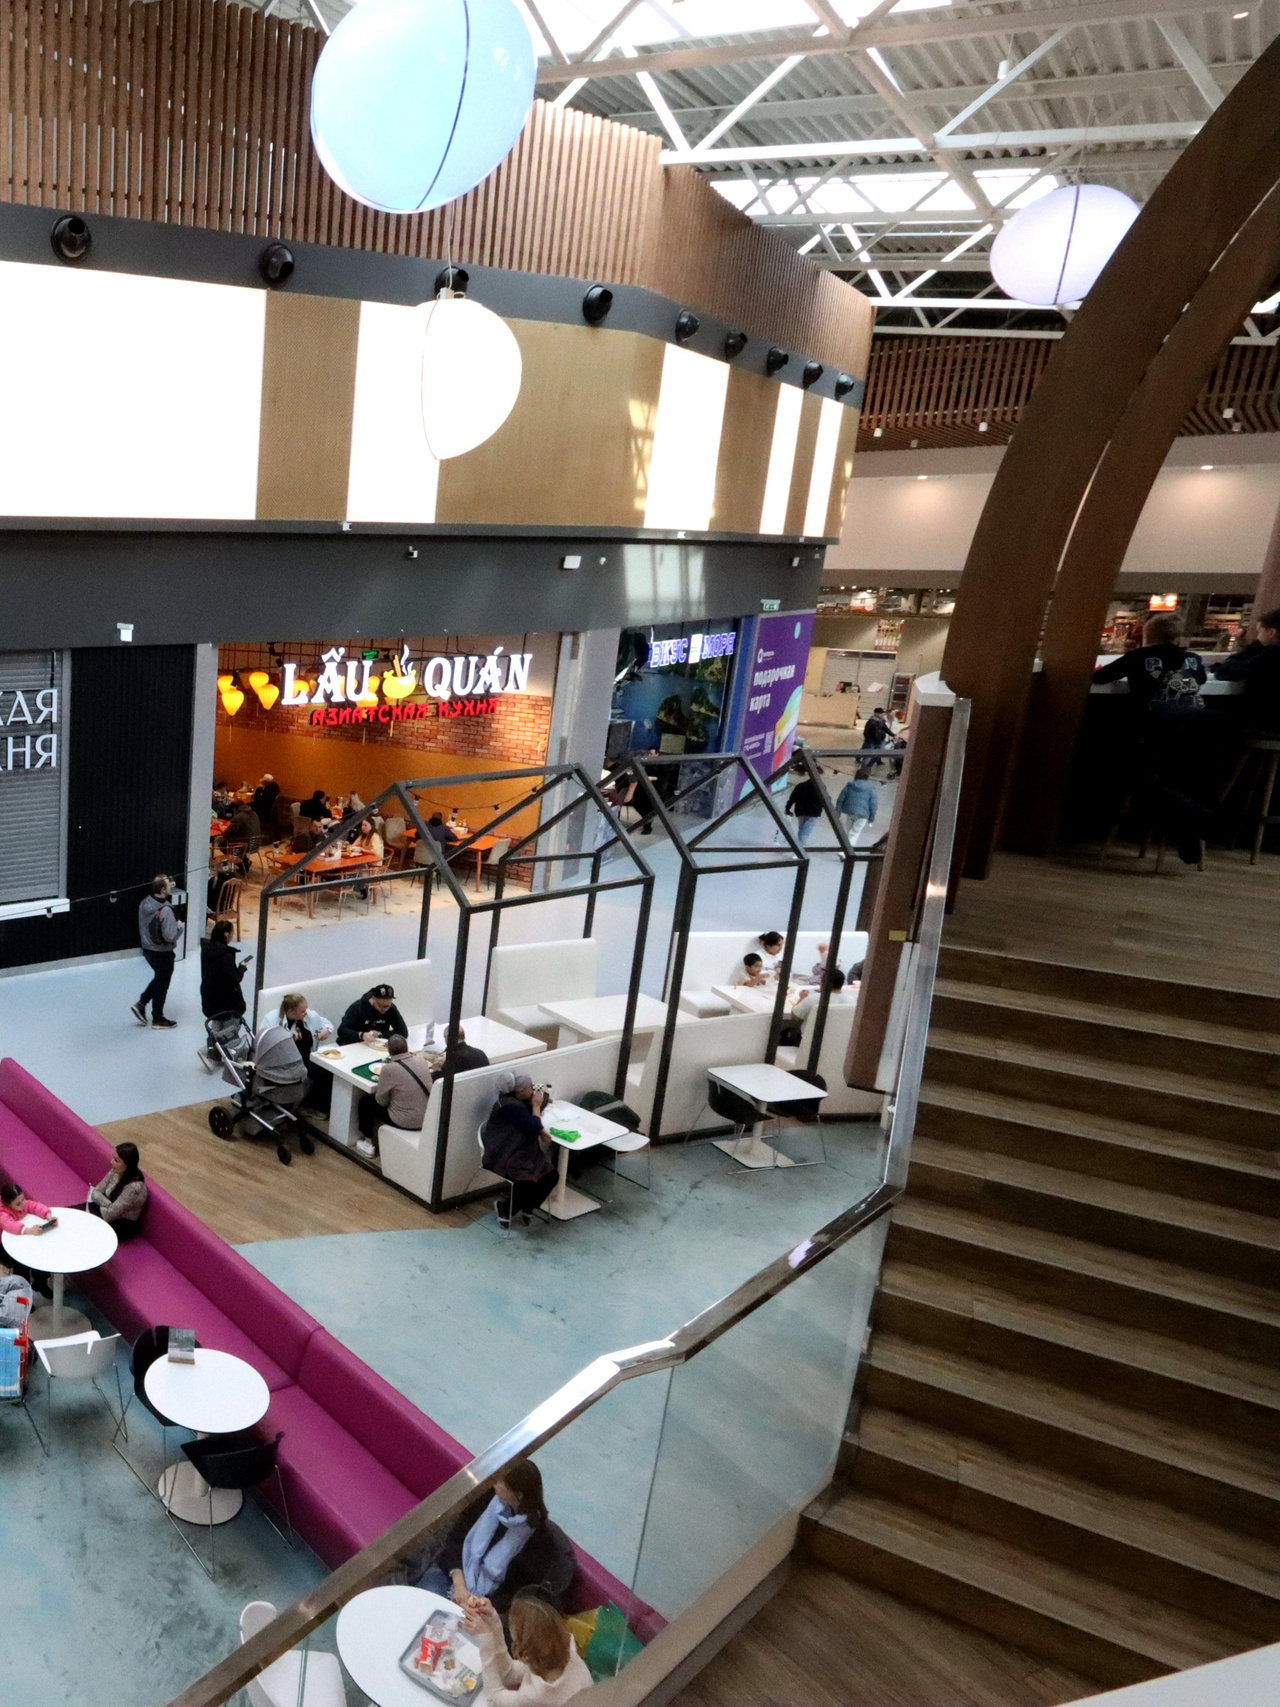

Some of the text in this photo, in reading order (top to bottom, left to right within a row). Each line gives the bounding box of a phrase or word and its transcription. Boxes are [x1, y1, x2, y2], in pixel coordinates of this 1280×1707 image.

[650, 632, 736, 668] ВКУС МОРЯ
[424, 646, 533, 701] QUÁN
[753, 664, 796, 688] подарочная
[312, 698, 500, 726] АЗИАТСКАЯ КУХНЯ
[749, 693, 771, 714] карта
